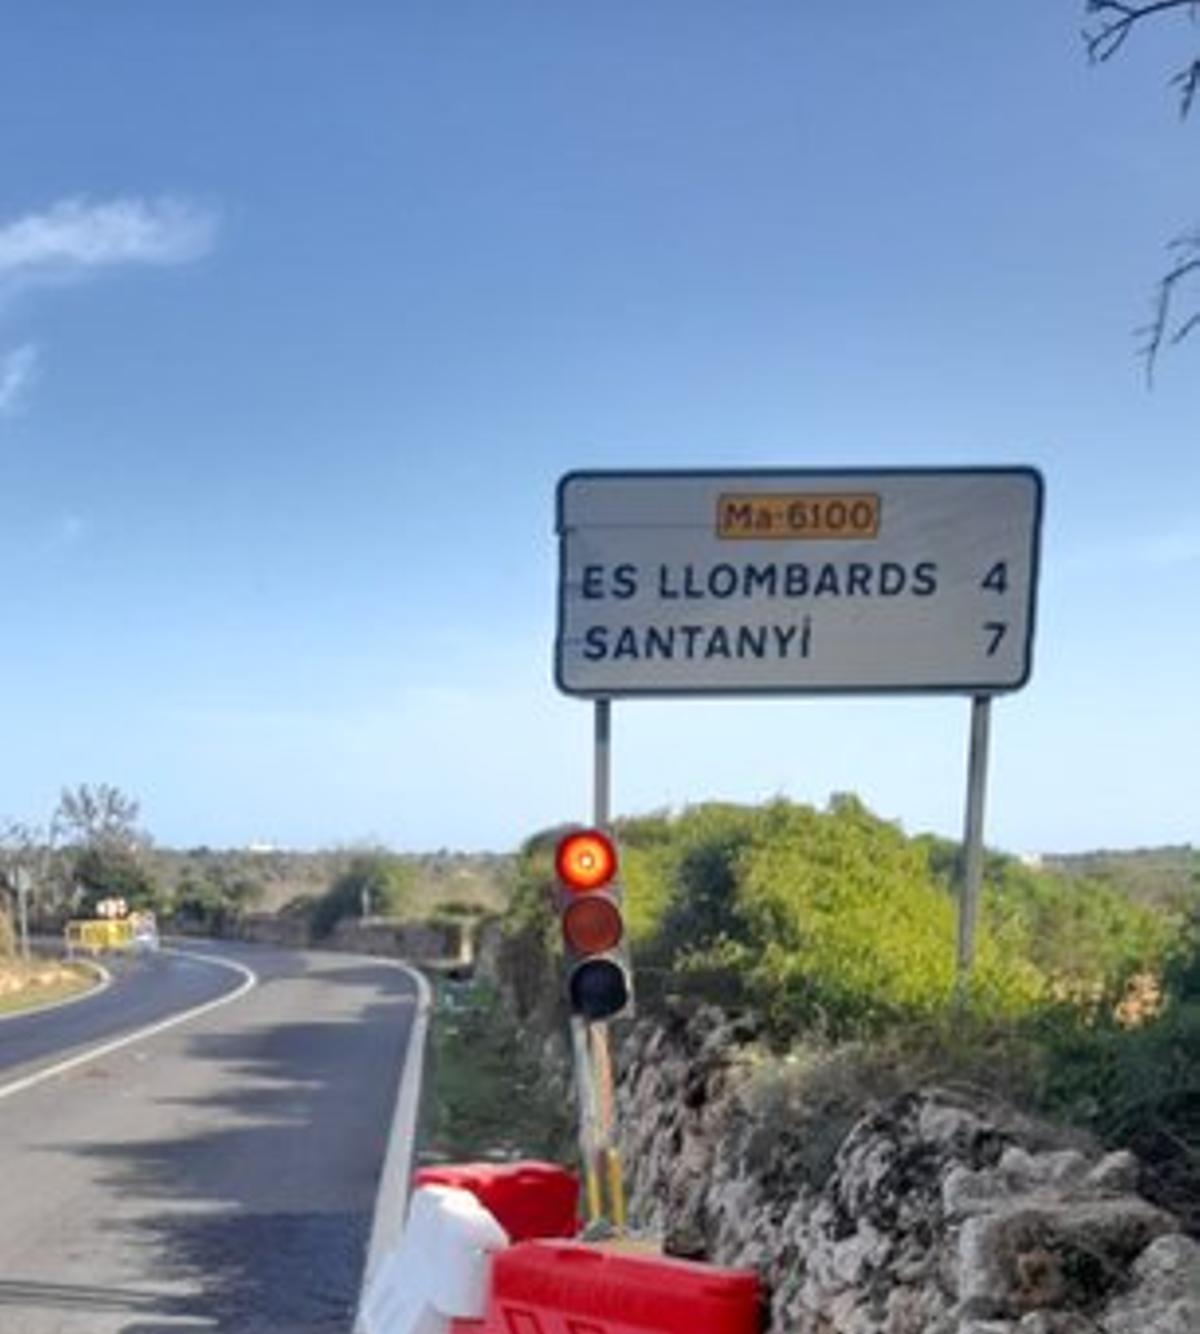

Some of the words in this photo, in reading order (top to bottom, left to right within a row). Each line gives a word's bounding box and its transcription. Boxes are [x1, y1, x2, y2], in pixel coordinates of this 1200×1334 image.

[722, 501, 874, 531] Ma-6100
[582, 564, 638, 599] ES
[659, 561, 938, 599] LLOMBARDS
[981, 562, 1009, 595] 4
[582, 616, 812, 661] SANTANYÍ
[983, 622, 1008, 656] 7
